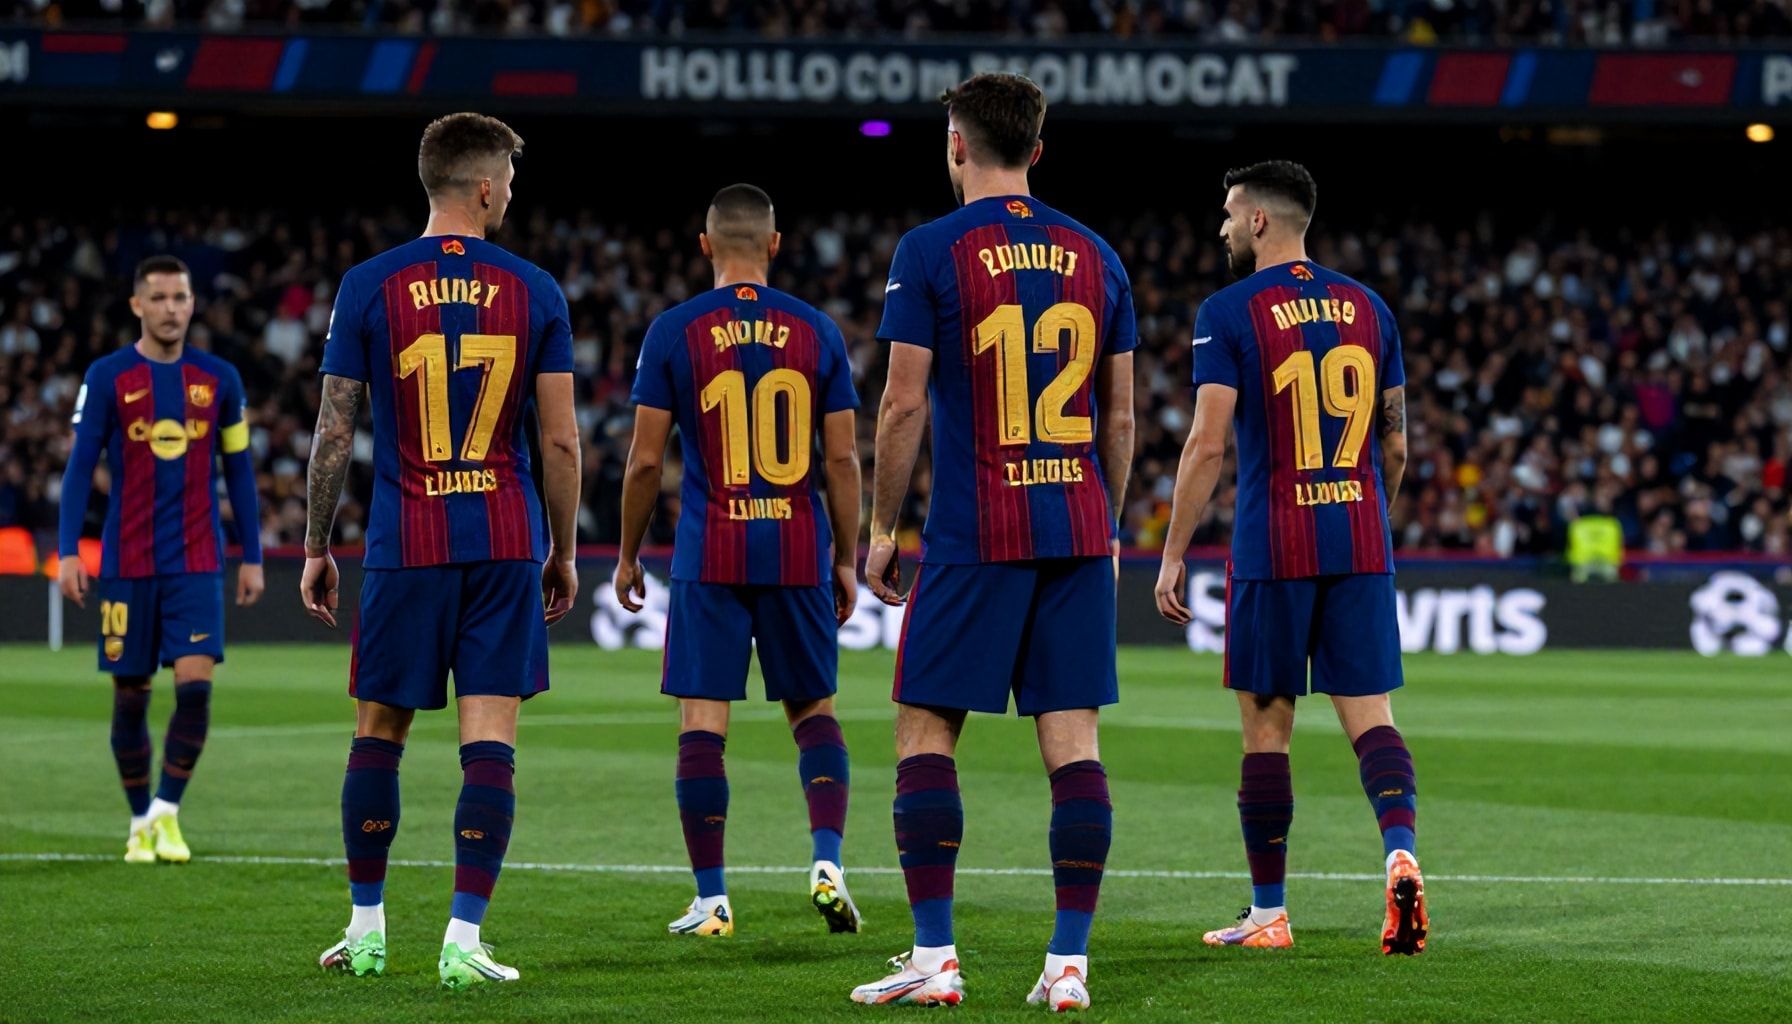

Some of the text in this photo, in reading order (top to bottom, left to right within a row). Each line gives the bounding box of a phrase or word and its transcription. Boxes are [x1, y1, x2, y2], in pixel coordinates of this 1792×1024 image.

[399, 333, 517, 462] 17
[700, 368, 812, 488] 10
[972, 302, 1096, 445] 12
[1272, 344, 1376, 471] 19
